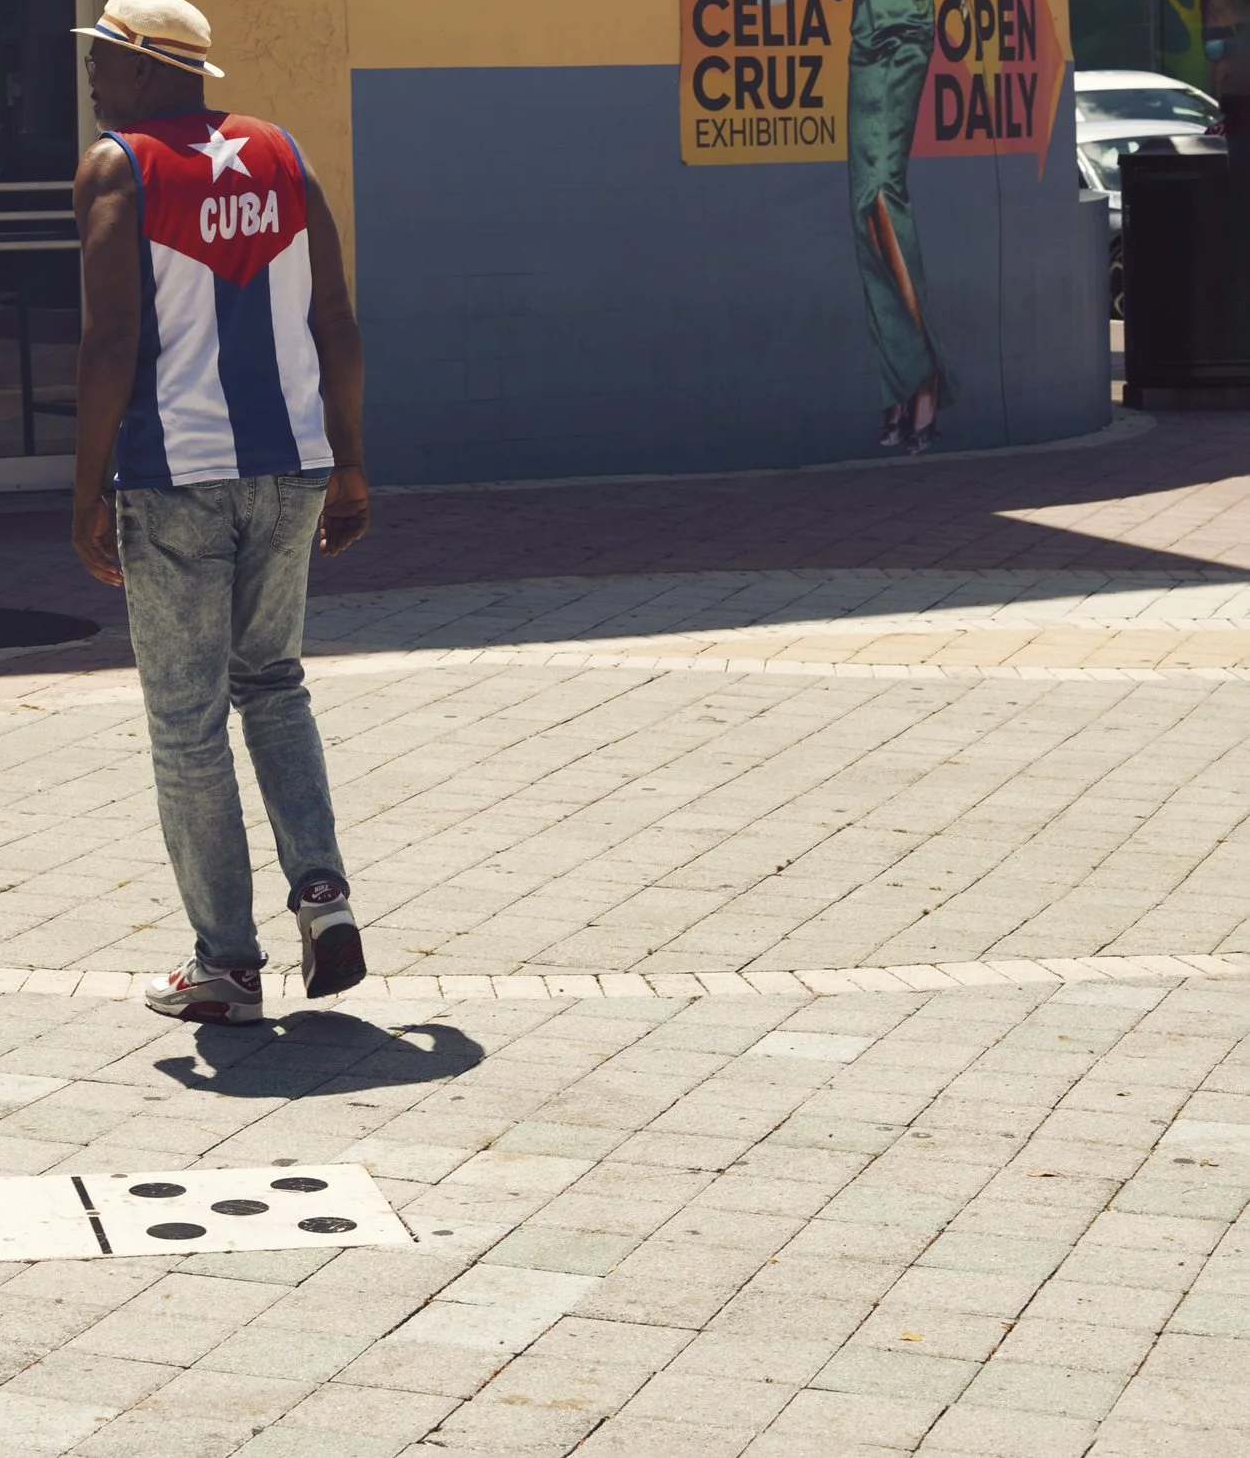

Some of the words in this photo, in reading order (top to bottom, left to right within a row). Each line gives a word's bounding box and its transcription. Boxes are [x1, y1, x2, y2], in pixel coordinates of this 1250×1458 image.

[692, 55, 824, 111] CRUZ
[934, 73, 1039, 141] DAILY
[696, 116, 836, 148] EXHIBITION
[200, 189, 280, 243] CUBA
